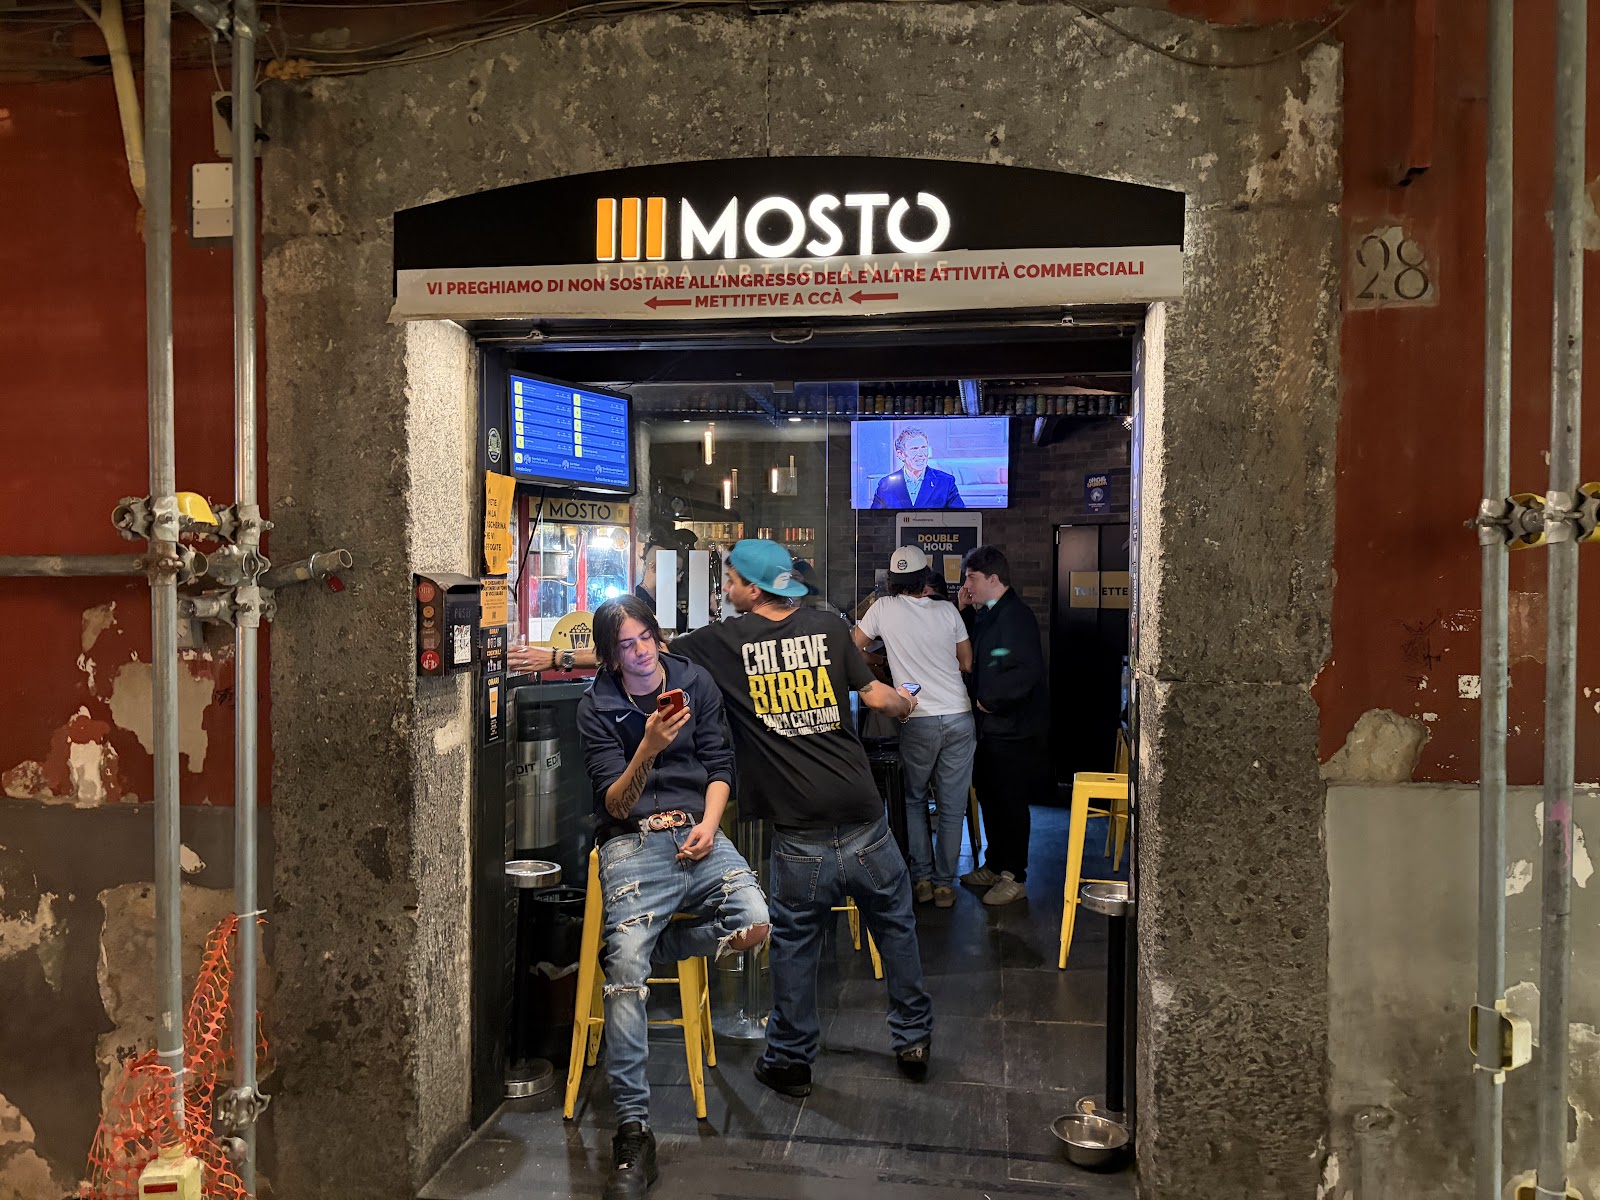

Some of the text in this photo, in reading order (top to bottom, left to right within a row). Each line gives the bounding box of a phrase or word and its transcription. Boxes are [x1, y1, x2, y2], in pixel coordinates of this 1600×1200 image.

[680, 192, 952, 259] MOSTO
[427, 282, 443, 295] VI
[447, 279, 543, 295] PREGHIAMO
[547, 279, 565, 292] DI
[569, 278, 605, 292] NON
[609, 276, 685, 291] SOSTARE
[814, 271, 868, 285] DELLE
[871, 268, 926, 284] ALTRE
[929, 261, 1010, 282] ATTIVITÀ
[1013, 261, 1145, 279] COMMERCIALI
[1356, 235, 1429, 300] 28
[695, 288, 844, 308] METTITEVE A CCÀ
[549, 501, 611, 520] MOSTO
[917, 533, 960, 543] DOUBLE
[923, 542, 953, 551] HOUR
[741, 634, 831, 675] CHI BEVE
[747, 665, 838, 714] BIRRA
